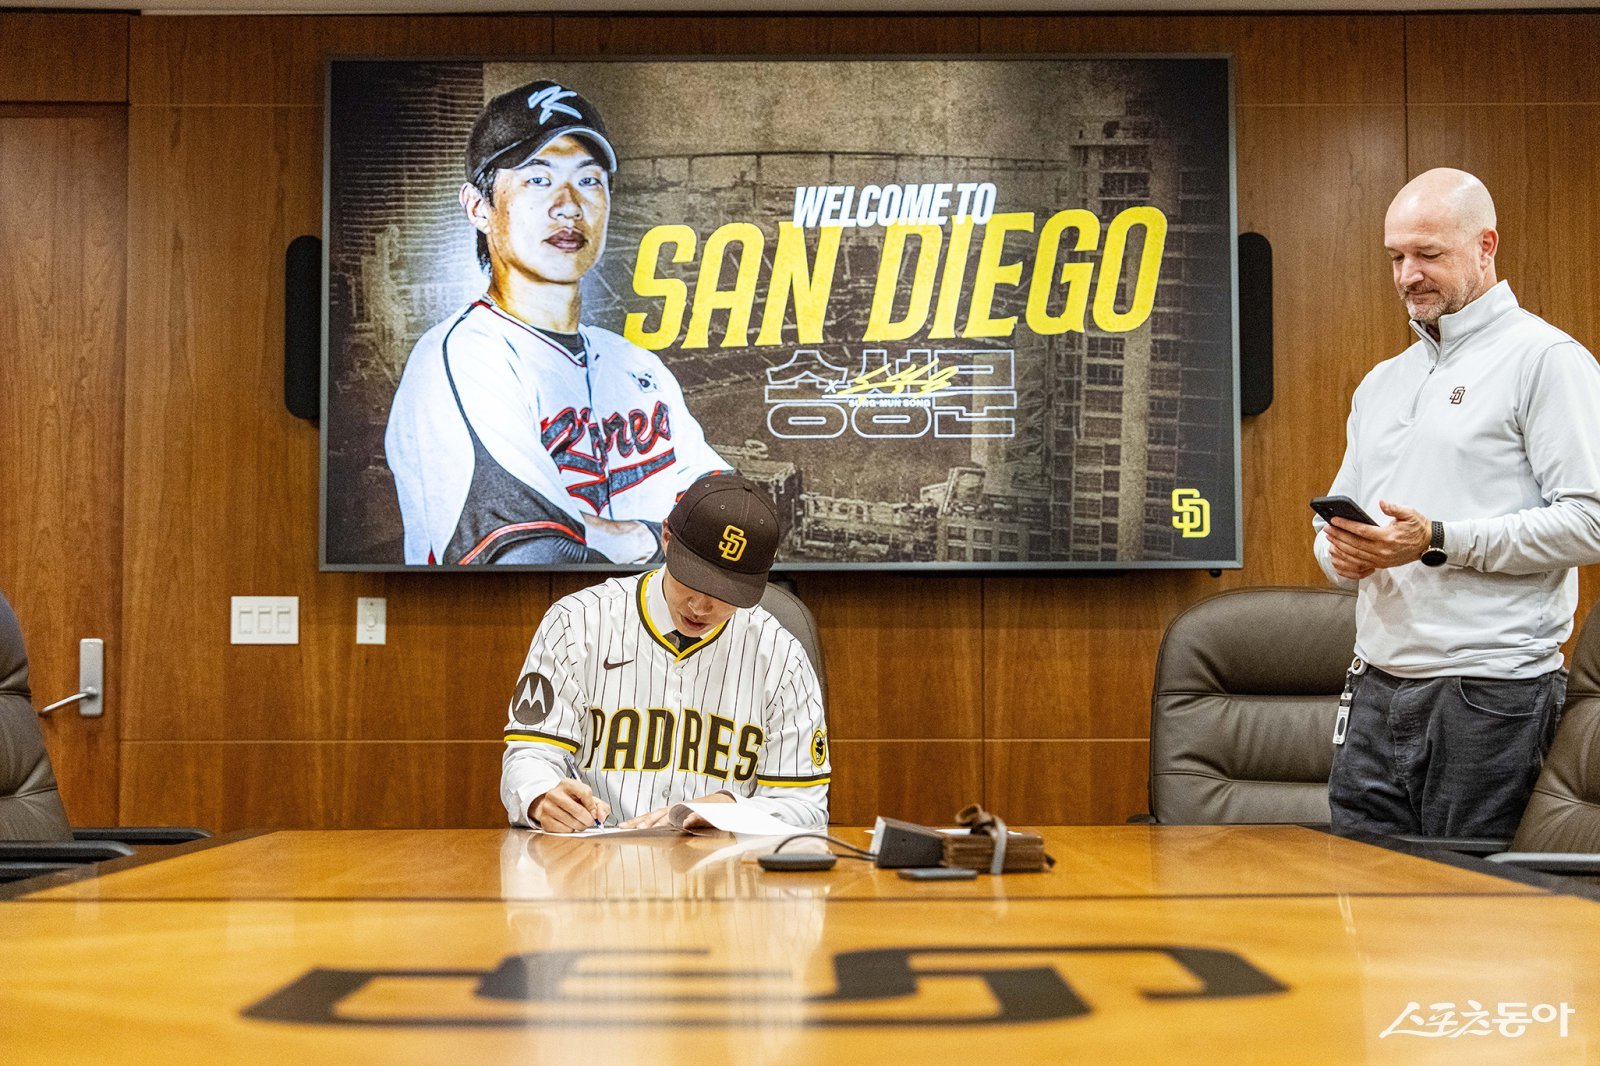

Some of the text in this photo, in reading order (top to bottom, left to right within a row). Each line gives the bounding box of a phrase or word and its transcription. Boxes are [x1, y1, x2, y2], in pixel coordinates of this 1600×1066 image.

[793, 182, 997, 227] WELCOME TO
[623, 206, 1168, 350] SAN DIEGO
[902, 398, 931, 408] SONG
[583, 707, 764, 782] PADRES
